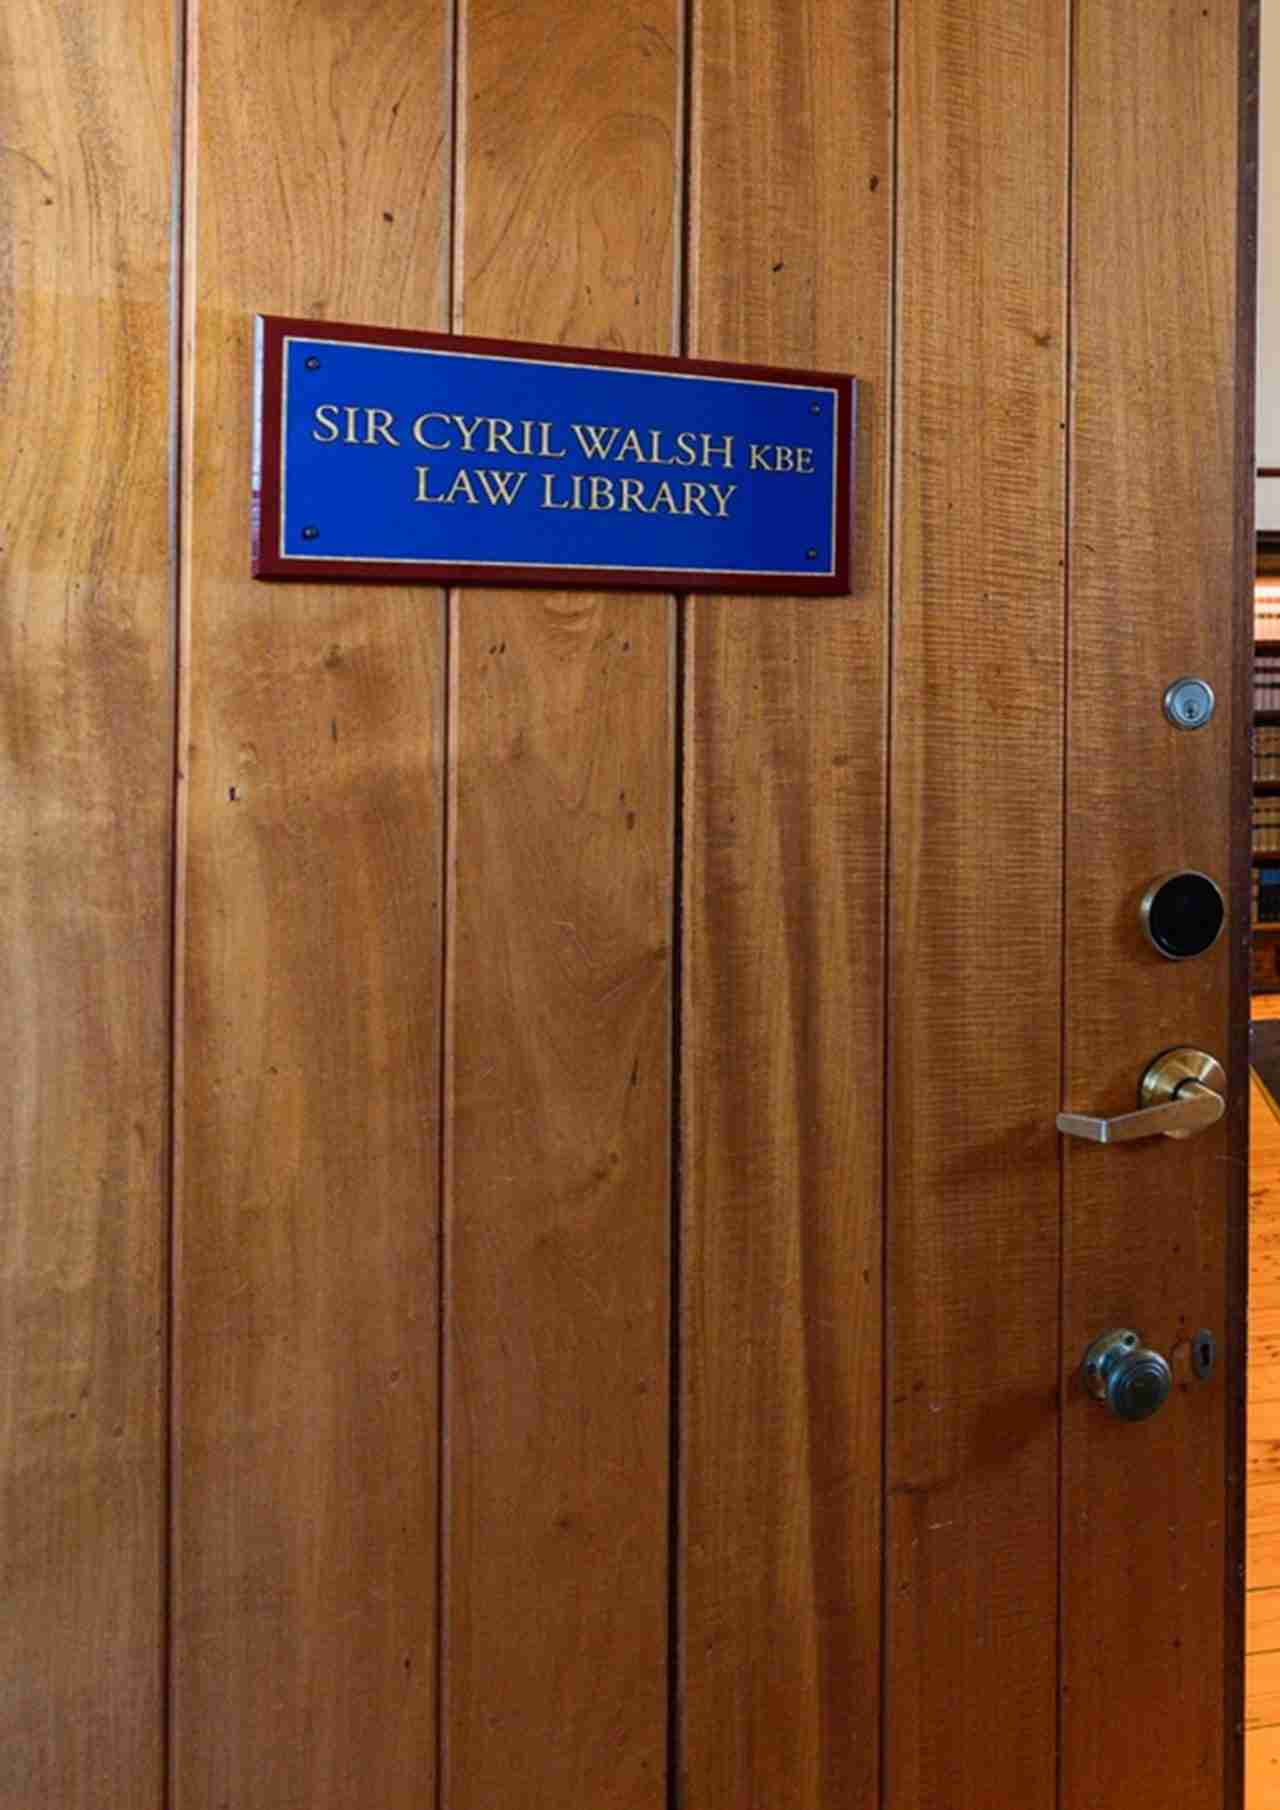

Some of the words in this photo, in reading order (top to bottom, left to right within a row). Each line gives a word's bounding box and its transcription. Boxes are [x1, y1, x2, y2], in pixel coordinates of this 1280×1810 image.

[313, 405, 400, 447] SIR
[412, 412, 567, 459] CYRIL
[571, 424, 736, 469] WALSH
[749, 444, 816, 474] KBE
[414, 465, 528, 506] LAW
[542, 473, 737, 518] LIBRARY
